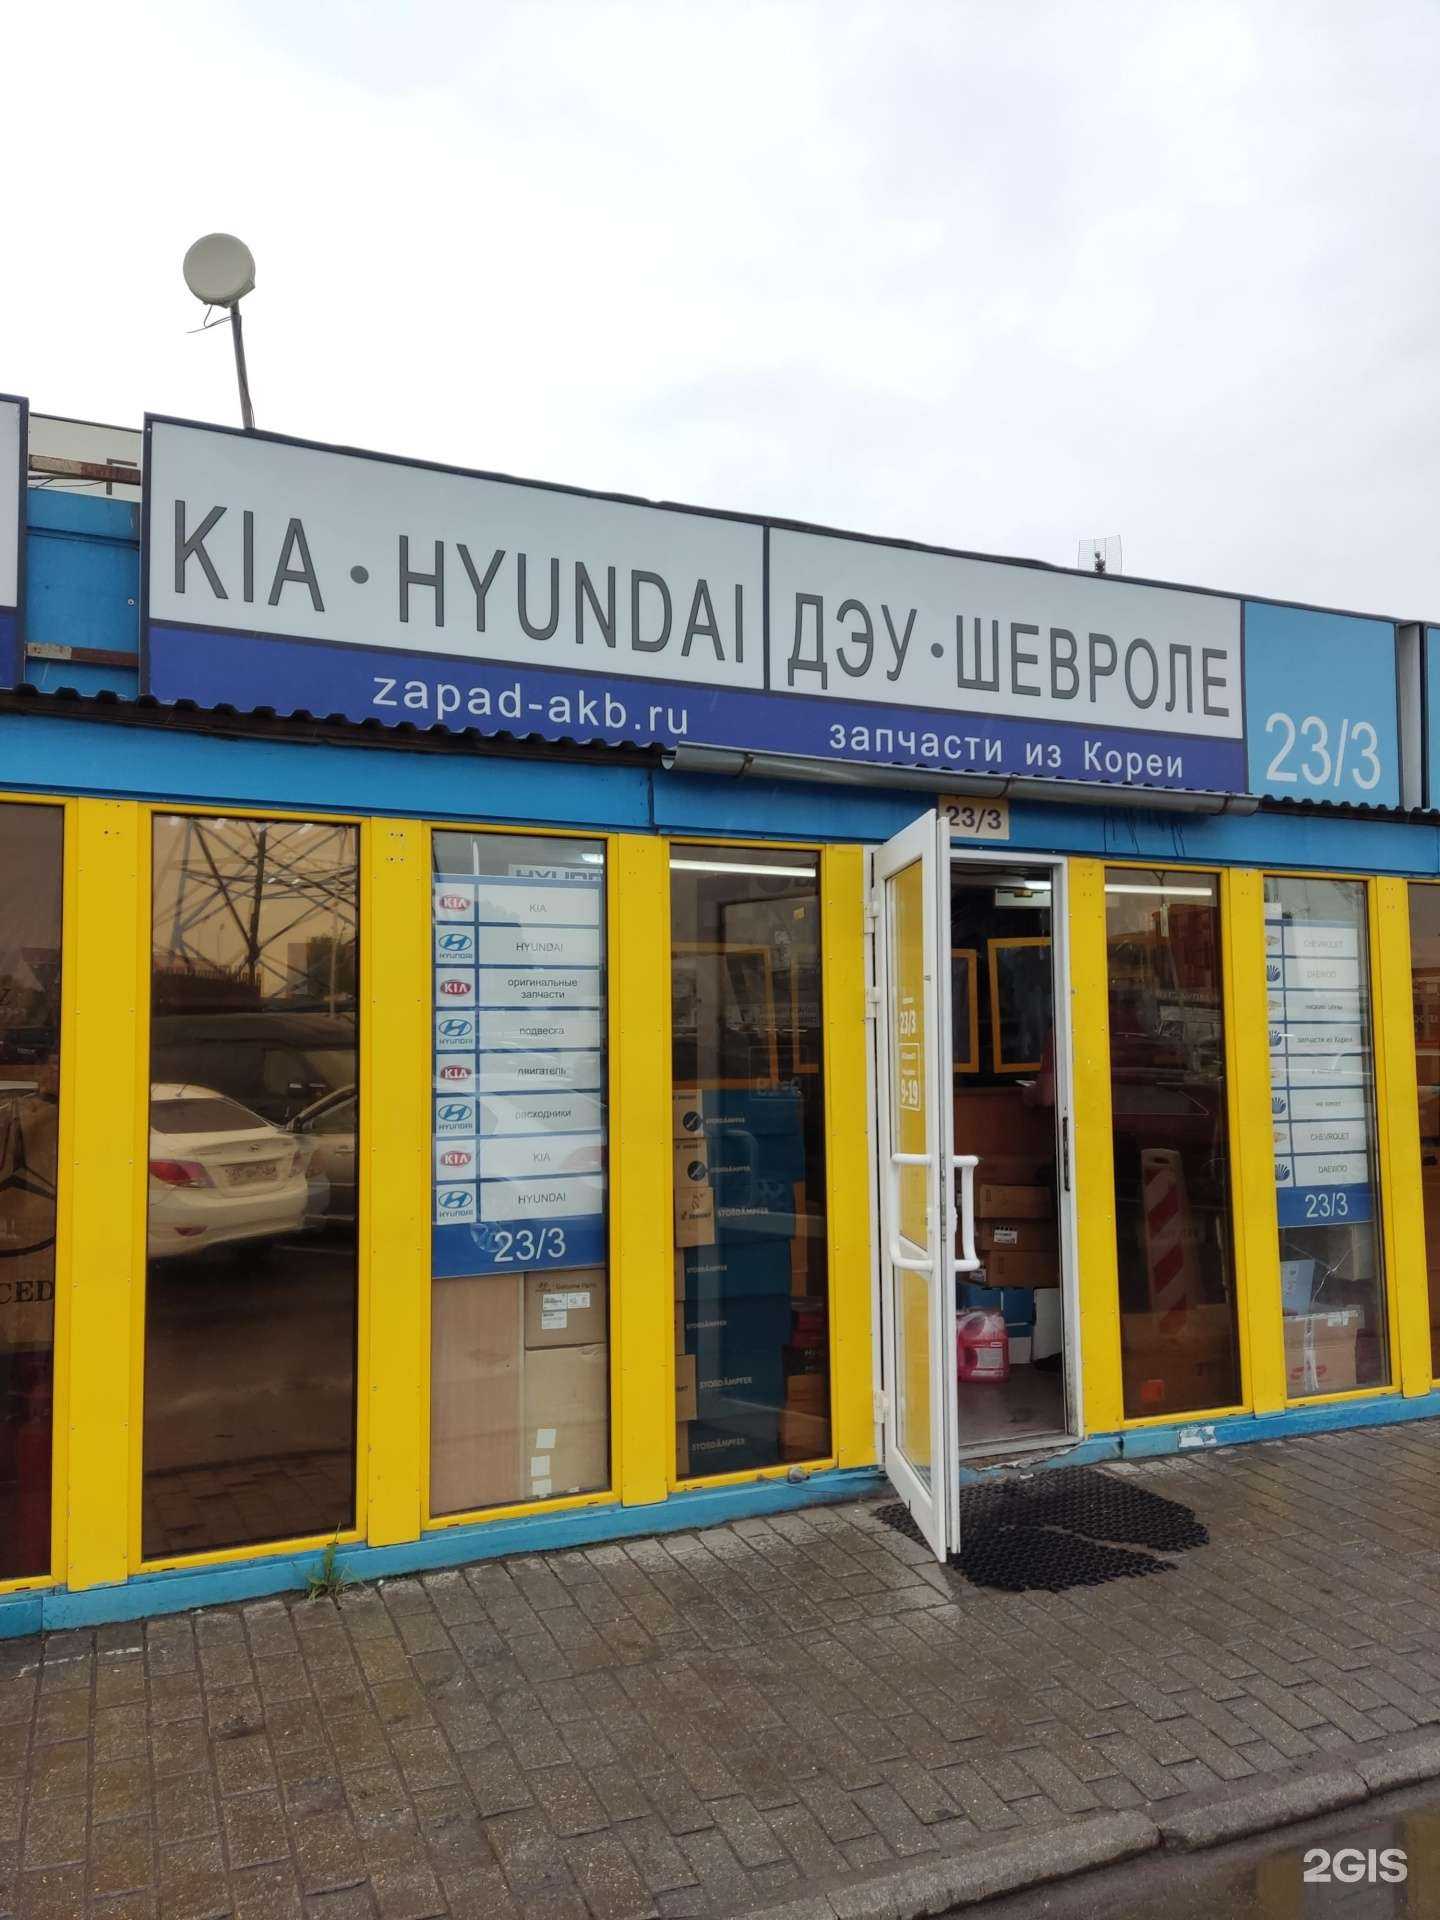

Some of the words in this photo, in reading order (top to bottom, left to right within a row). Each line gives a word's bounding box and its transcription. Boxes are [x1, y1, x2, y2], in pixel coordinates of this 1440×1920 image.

[174, 499, 325, 611] KIA
[399, 534, 743, 663] HYUNDAI
[787, 592, 917, 690] ДЭУ
[956, 614, 1229, 717] ШЕВРОЛЕ
[372, 676, 688, 735] zapad-akb.ru
[829, 723, 1003, 764] запчасти
[1026, 745, 1062, 768] из
[1084, 742, 1183, 779] Кореи
[1265, 712, 1381, 790] 23/3
[945, 805, 1001, 833] 23/3
[443, 896, 468, 909] KIA
[529, 904, 547, 912] KIA
[516, 942, 563, 952] HYUNDAI
[444, 982, 468, 994] KIA
[508, 979, 578, 988] оригинальные
[521, 992, 565, 1000] запчасти
[444, 1067, 468, 1079] KIA
[439, 1123, 473, 1131] HYUNDAI
[444, 1153, 468, 1165] KIA
[534, 1153, 551, 1162] KIA
[518, 1193, 566, 1205] HYUNDAI
[1305, 1193, 1348, 1218] 23/3
[439, 1210, 474, 1218] HYUNDAI
[494, 1227, 566, 1262] 23/3
